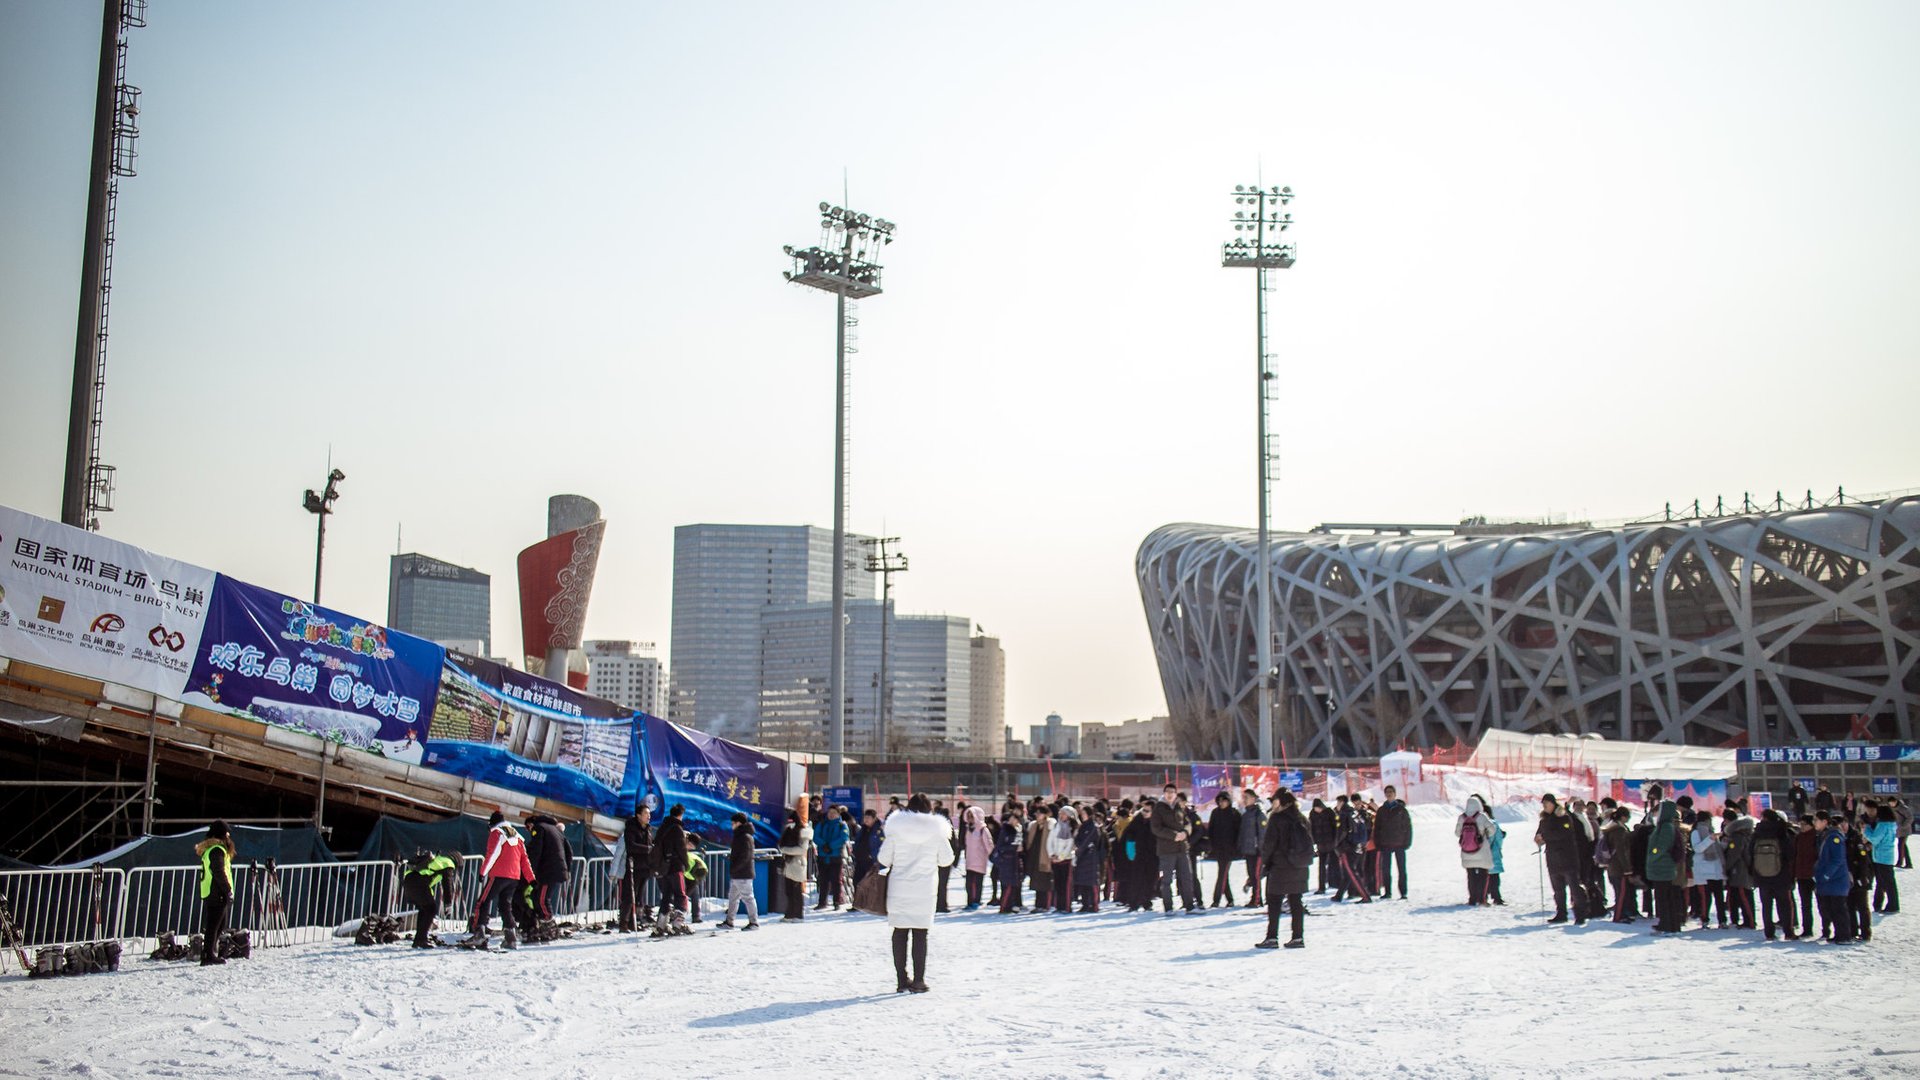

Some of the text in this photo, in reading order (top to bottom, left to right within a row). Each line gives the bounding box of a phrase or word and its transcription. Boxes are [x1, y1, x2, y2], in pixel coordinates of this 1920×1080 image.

[15, 537, 204, 608] 国家体育场·鸟巢
[11, 559, 70, 583] NATIONAL
[74, 576, 122, 597] STADIUM
[134, 593, 171, 610] BIRD'S
[176, 604, 200, 619] NEST
[18, 619, 74, 640] 鸟巢文化中心
[81, 633, 126, 651] 鸟巢商业
[95, 646, 124, 657] COMPANY
[132, 647, 189, 669] 鸟巢文化传媒
[208, 641, 319, 694] 欢乐鸟巢
[329, 673, 420, 723] 圆梦冰雪
[502, 682, 582, 717] 家庭食材新鲜超市
[1851, 713, 1873, 740] K
[1751, 746, 1881, 762] 鸟巢欢乐冰雪季
[505, 764, 548, 783] 全空间保鲜
